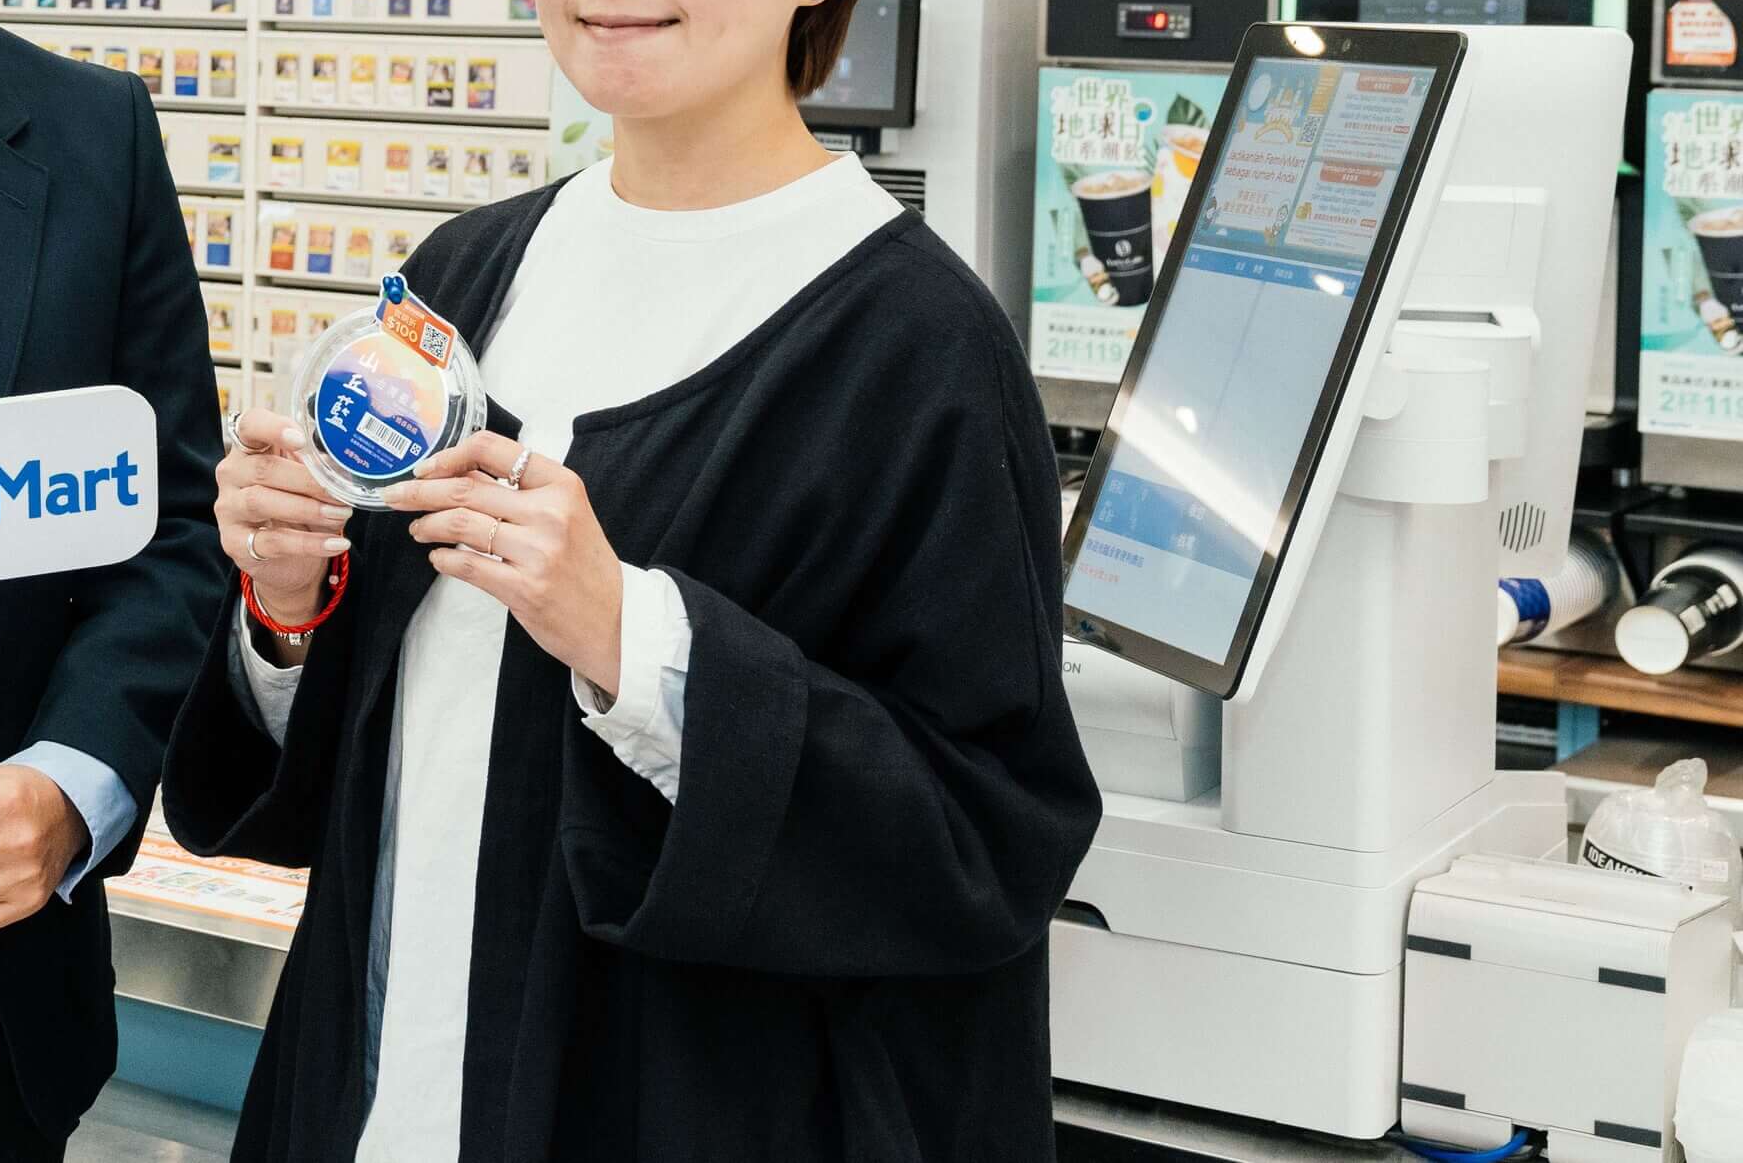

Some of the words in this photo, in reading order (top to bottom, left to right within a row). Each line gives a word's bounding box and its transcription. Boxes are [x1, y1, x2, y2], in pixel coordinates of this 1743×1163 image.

[1077, 80, 1129, 109] 世界
[1054, 110, 1140, 140] 地球日
[386, 315, 418, 343] $100
